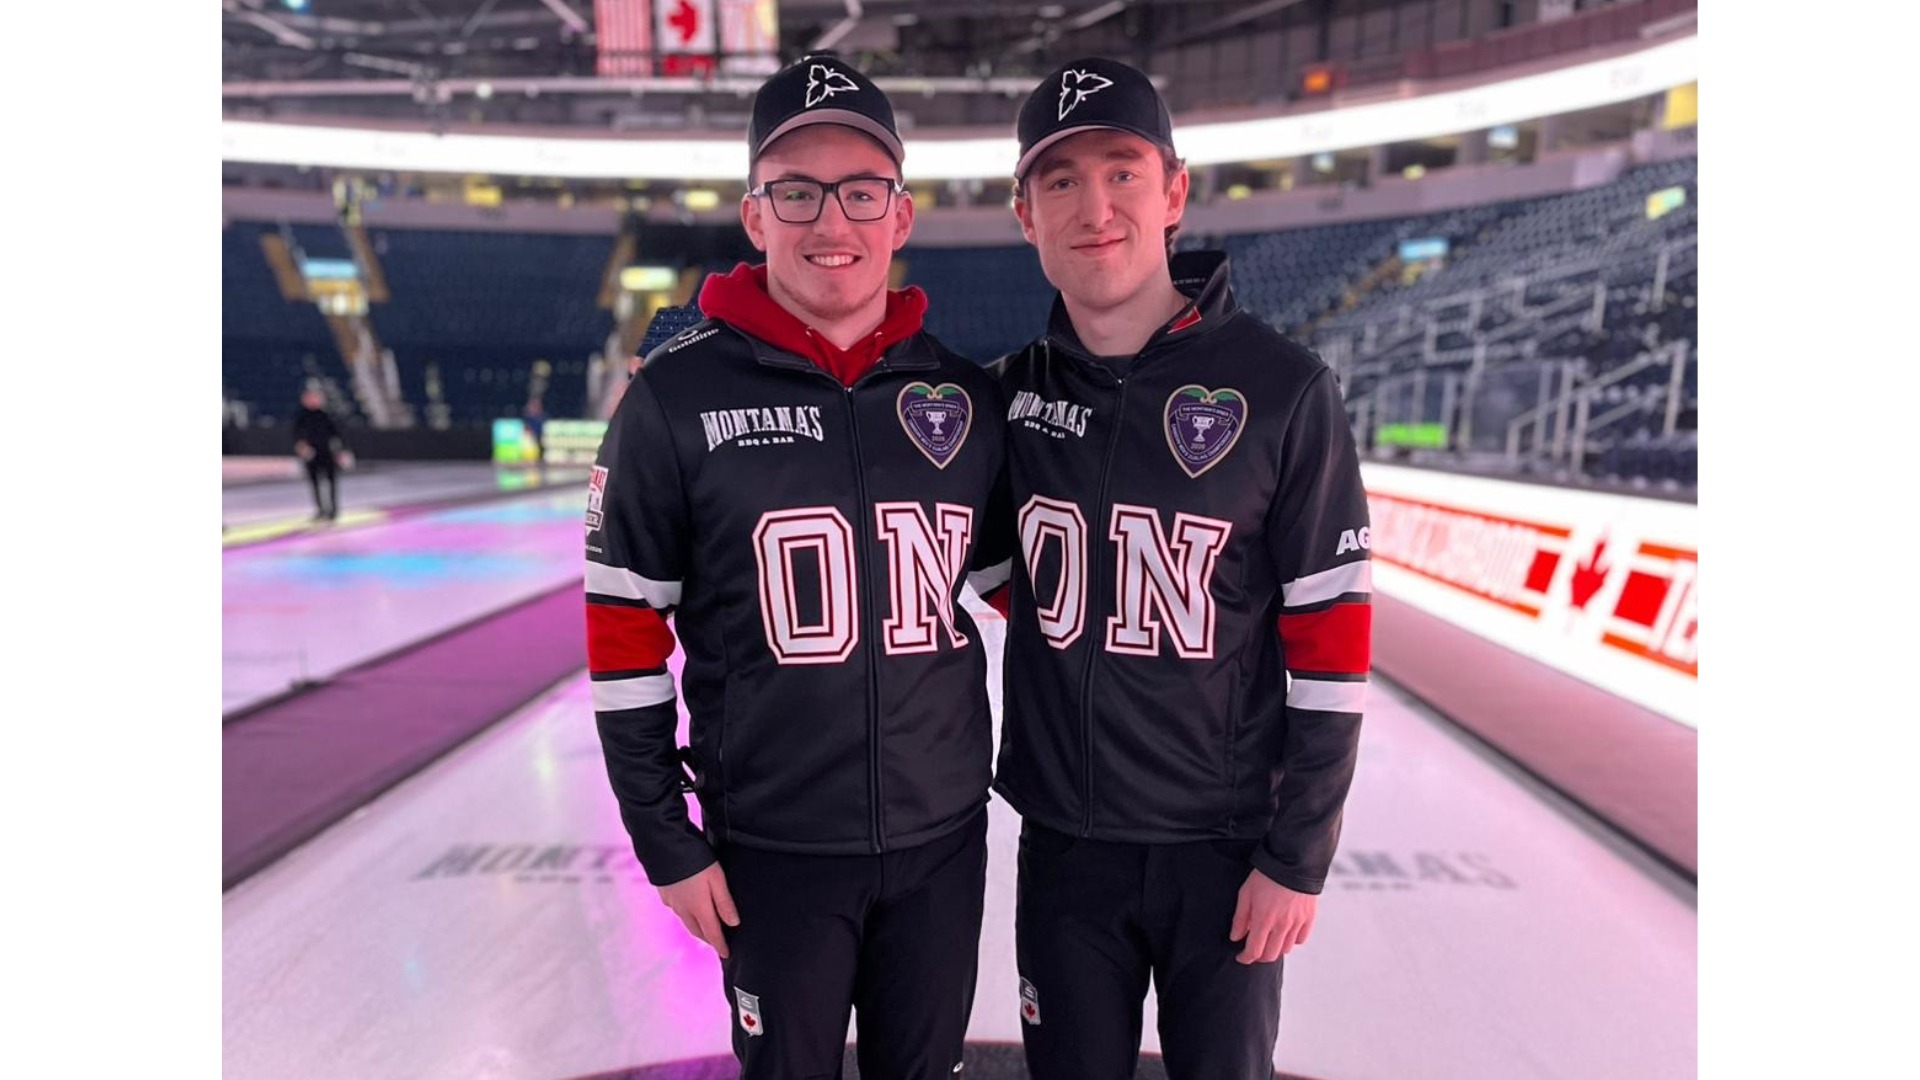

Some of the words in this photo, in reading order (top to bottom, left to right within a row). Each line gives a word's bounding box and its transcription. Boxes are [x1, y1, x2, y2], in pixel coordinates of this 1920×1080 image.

[668, 328, 719, 353] Goldline
[700, 405, 824, 452] MONTANA'S
[1007, 390, 1093, 438] MONTANA'S
[753, 502, 973, 665] ON
[1018, 494, 1233, 659] ON
